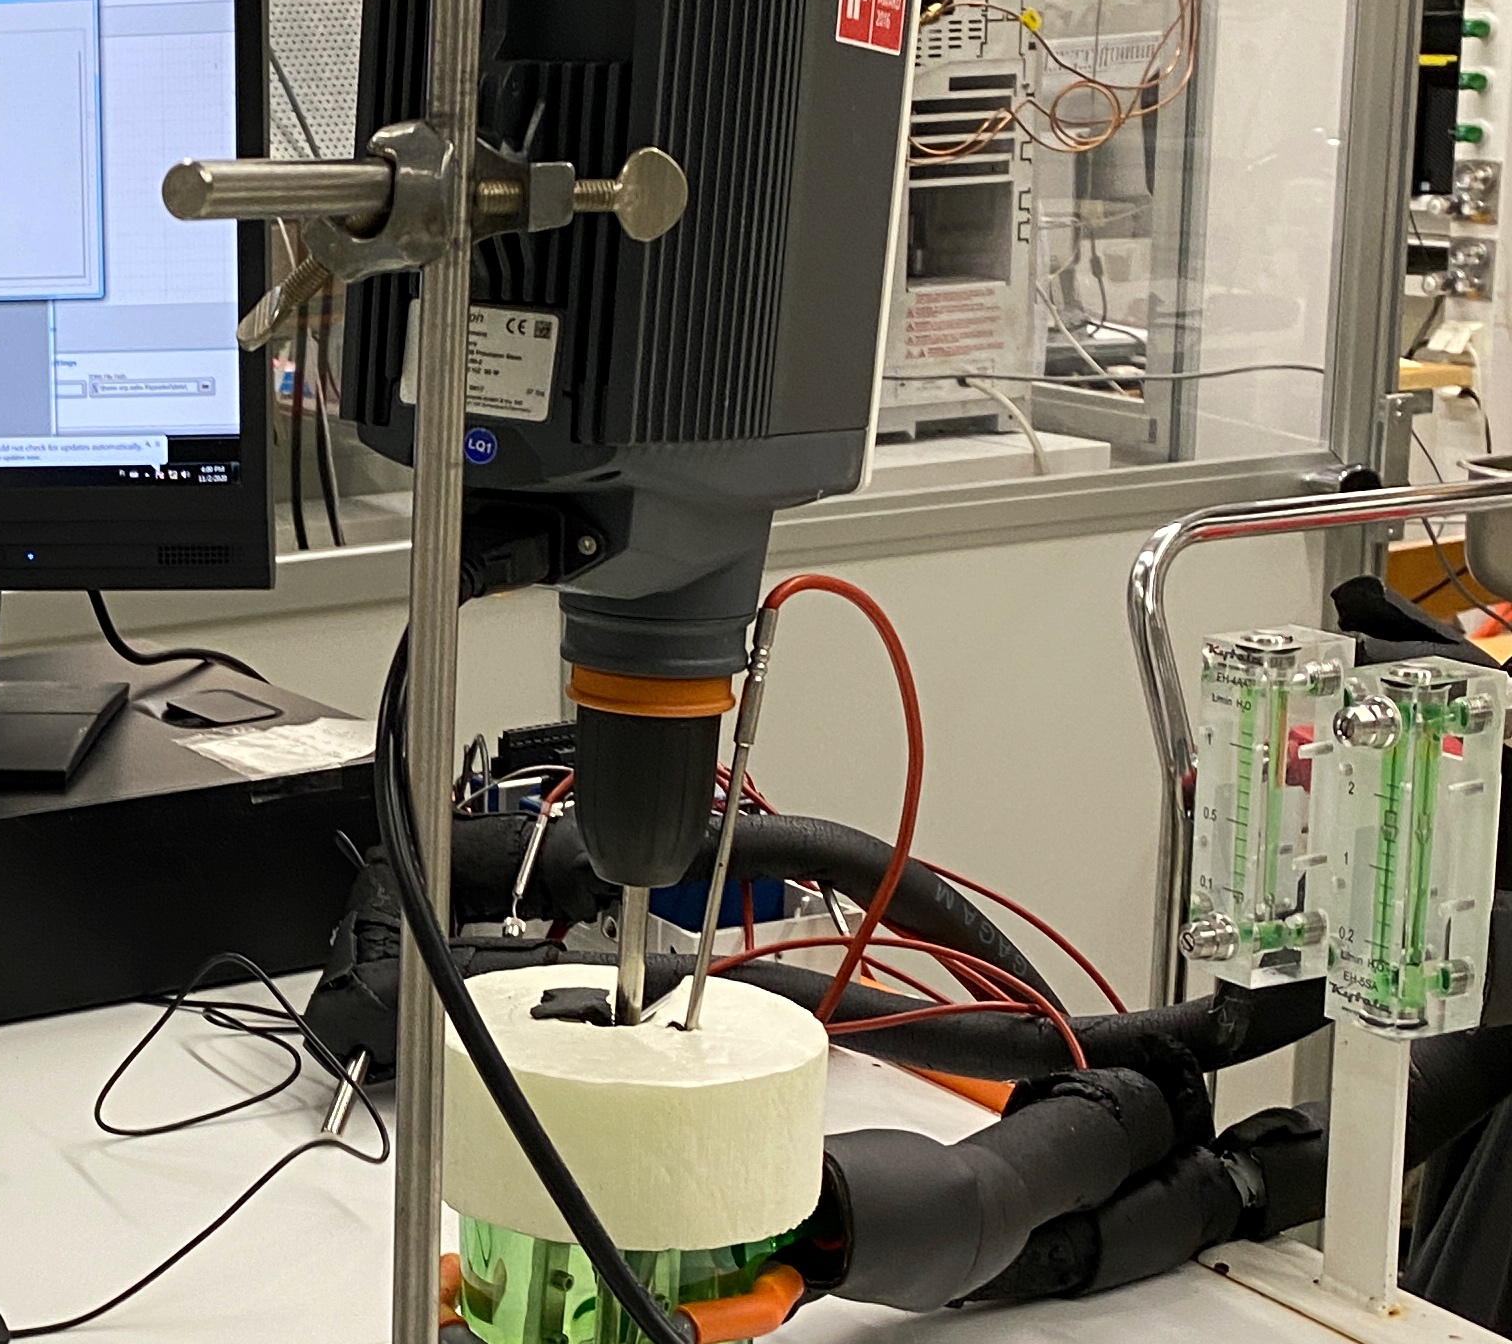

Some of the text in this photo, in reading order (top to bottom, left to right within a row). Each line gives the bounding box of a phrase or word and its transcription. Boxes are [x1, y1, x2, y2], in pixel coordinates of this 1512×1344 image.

[505, 317, 527, 336] CE
[467, 437, 493, 455] LQ1
[1348, 781, 1355, 795] 2
[1203, 806, 1217, 821] 0.5
[1344, 851, 1349, 865] 1
[1200, 874, 1213, 890] 0.1
[1338, 926, 1354, 943] 0.2
